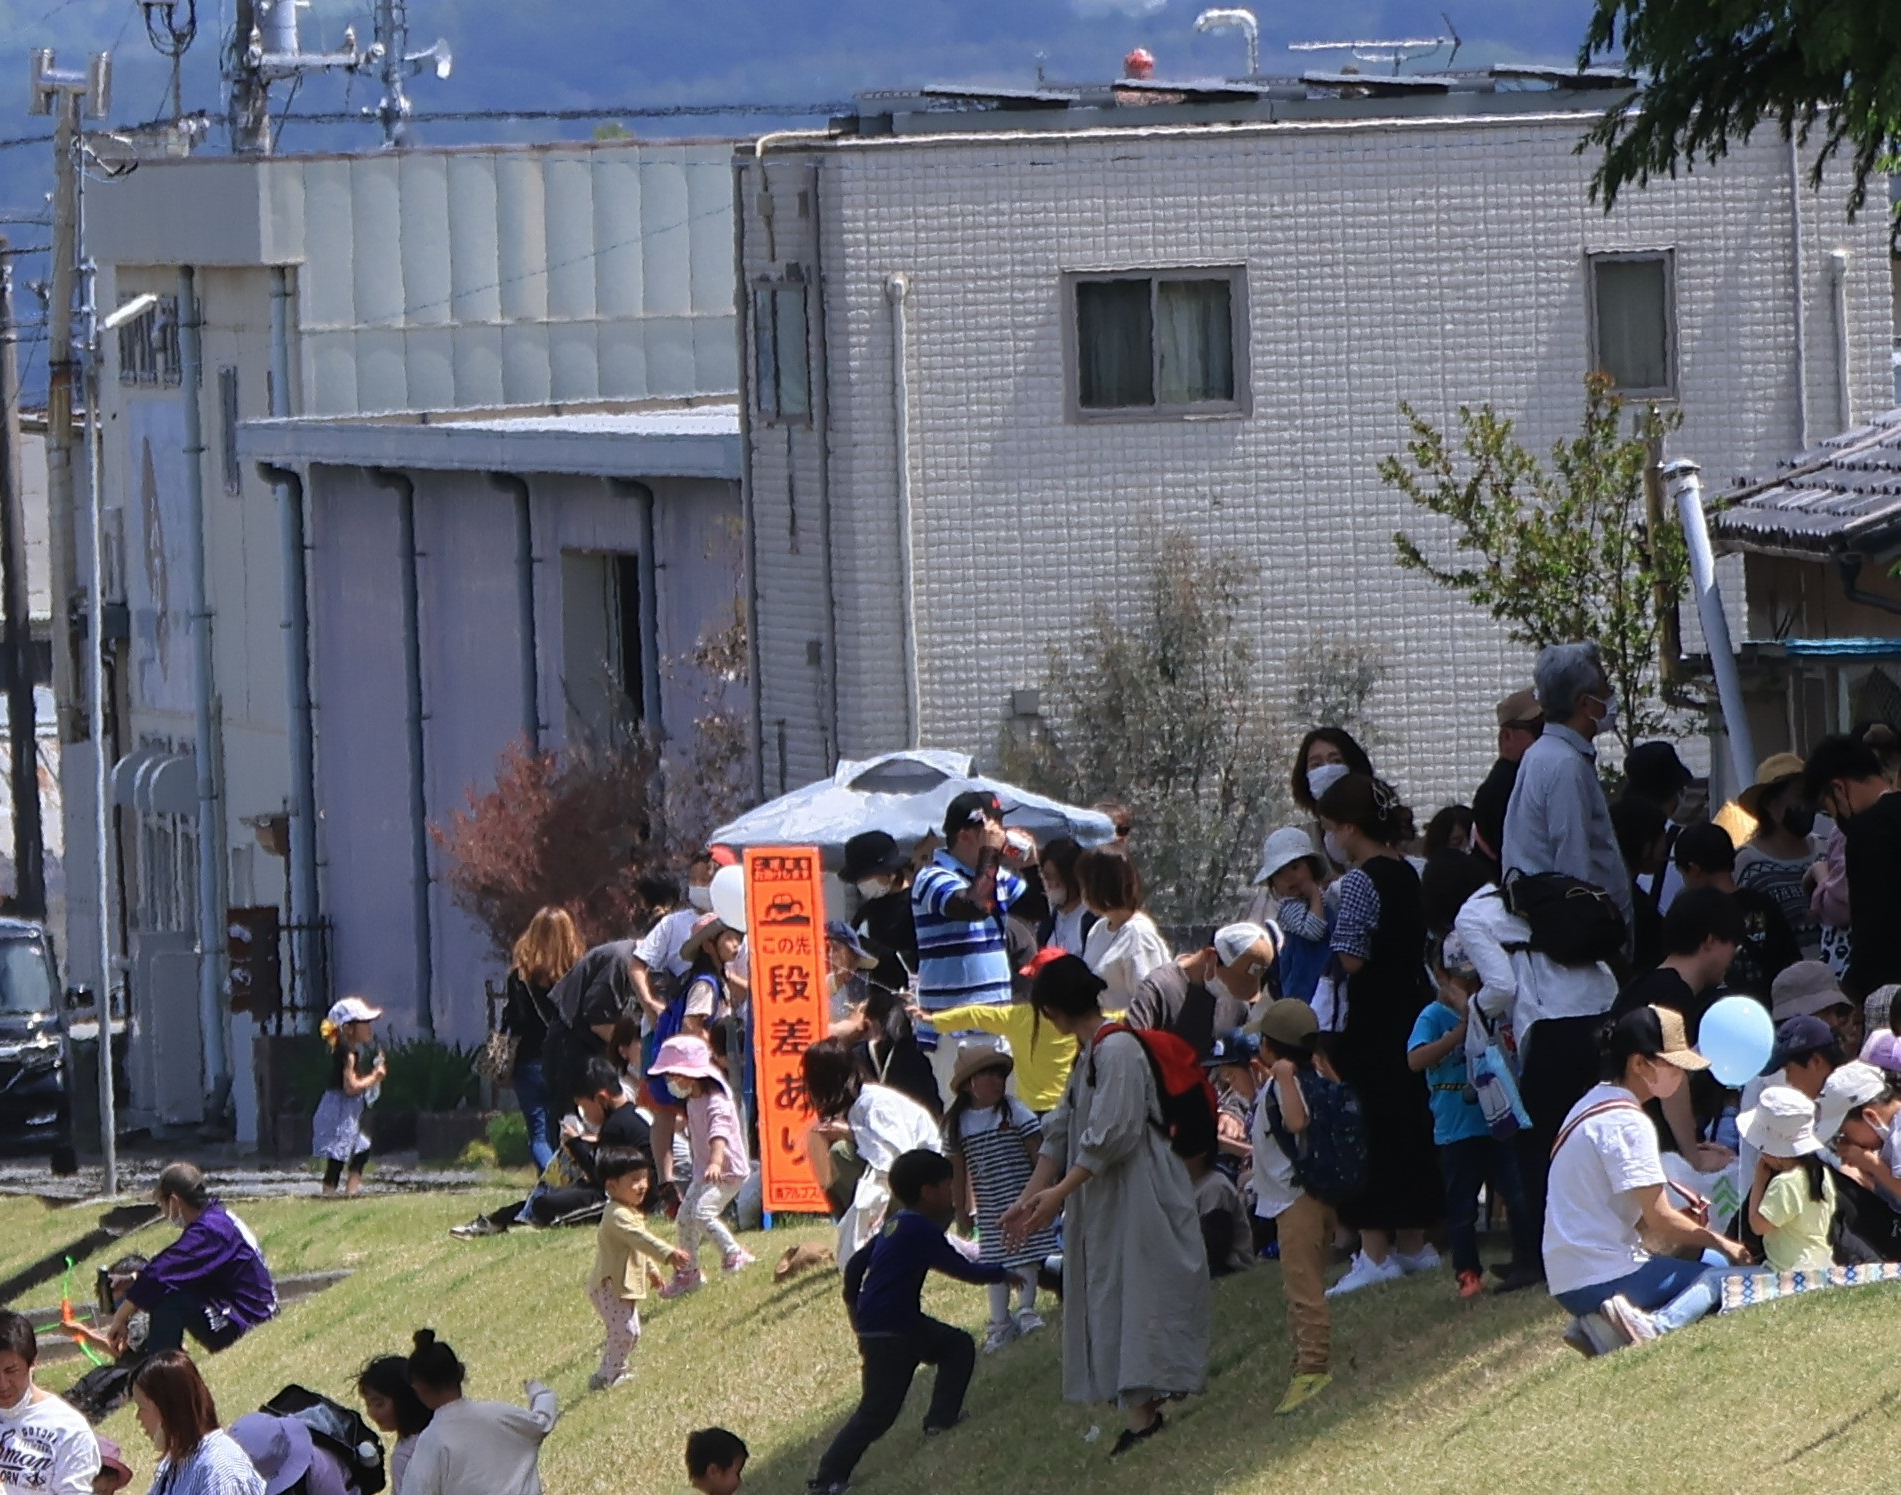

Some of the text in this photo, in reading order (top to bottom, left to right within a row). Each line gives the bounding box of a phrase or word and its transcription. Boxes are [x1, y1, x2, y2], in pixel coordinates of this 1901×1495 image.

[762, 935, 811, 955] この先
[768, 963, 813, 1166] 段差あり
